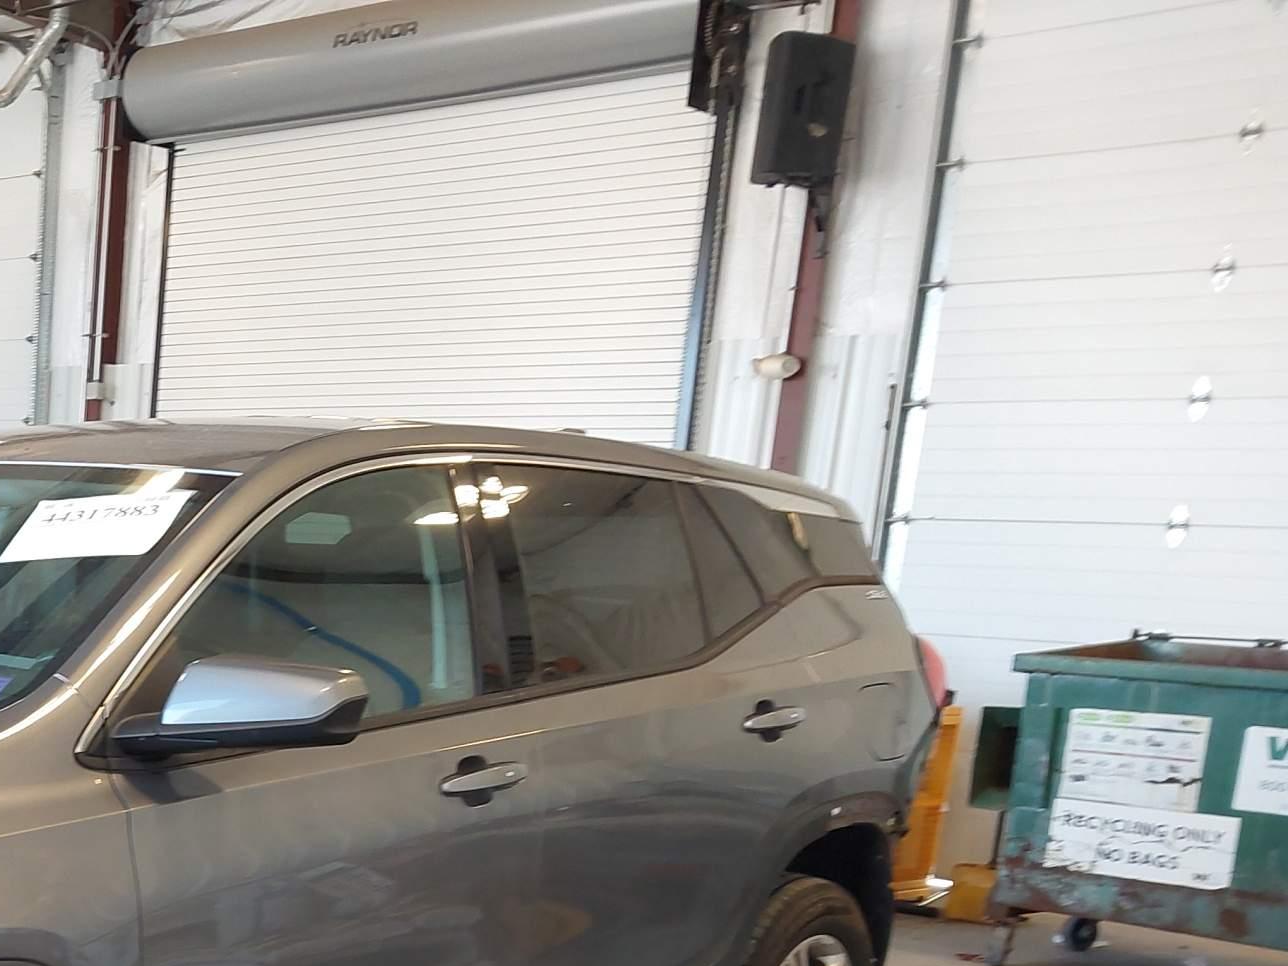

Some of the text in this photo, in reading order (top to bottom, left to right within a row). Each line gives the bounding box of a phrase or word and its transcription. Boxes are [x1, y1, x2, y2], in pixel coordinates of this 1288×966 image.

[333, 20, 418, 48] RAYNOR
[41, 504, 160, 523] 44317883
[1062, 812, 1226, 843] RECYCLING ONLY
[1127, 850, 1180, 870] BAGS
